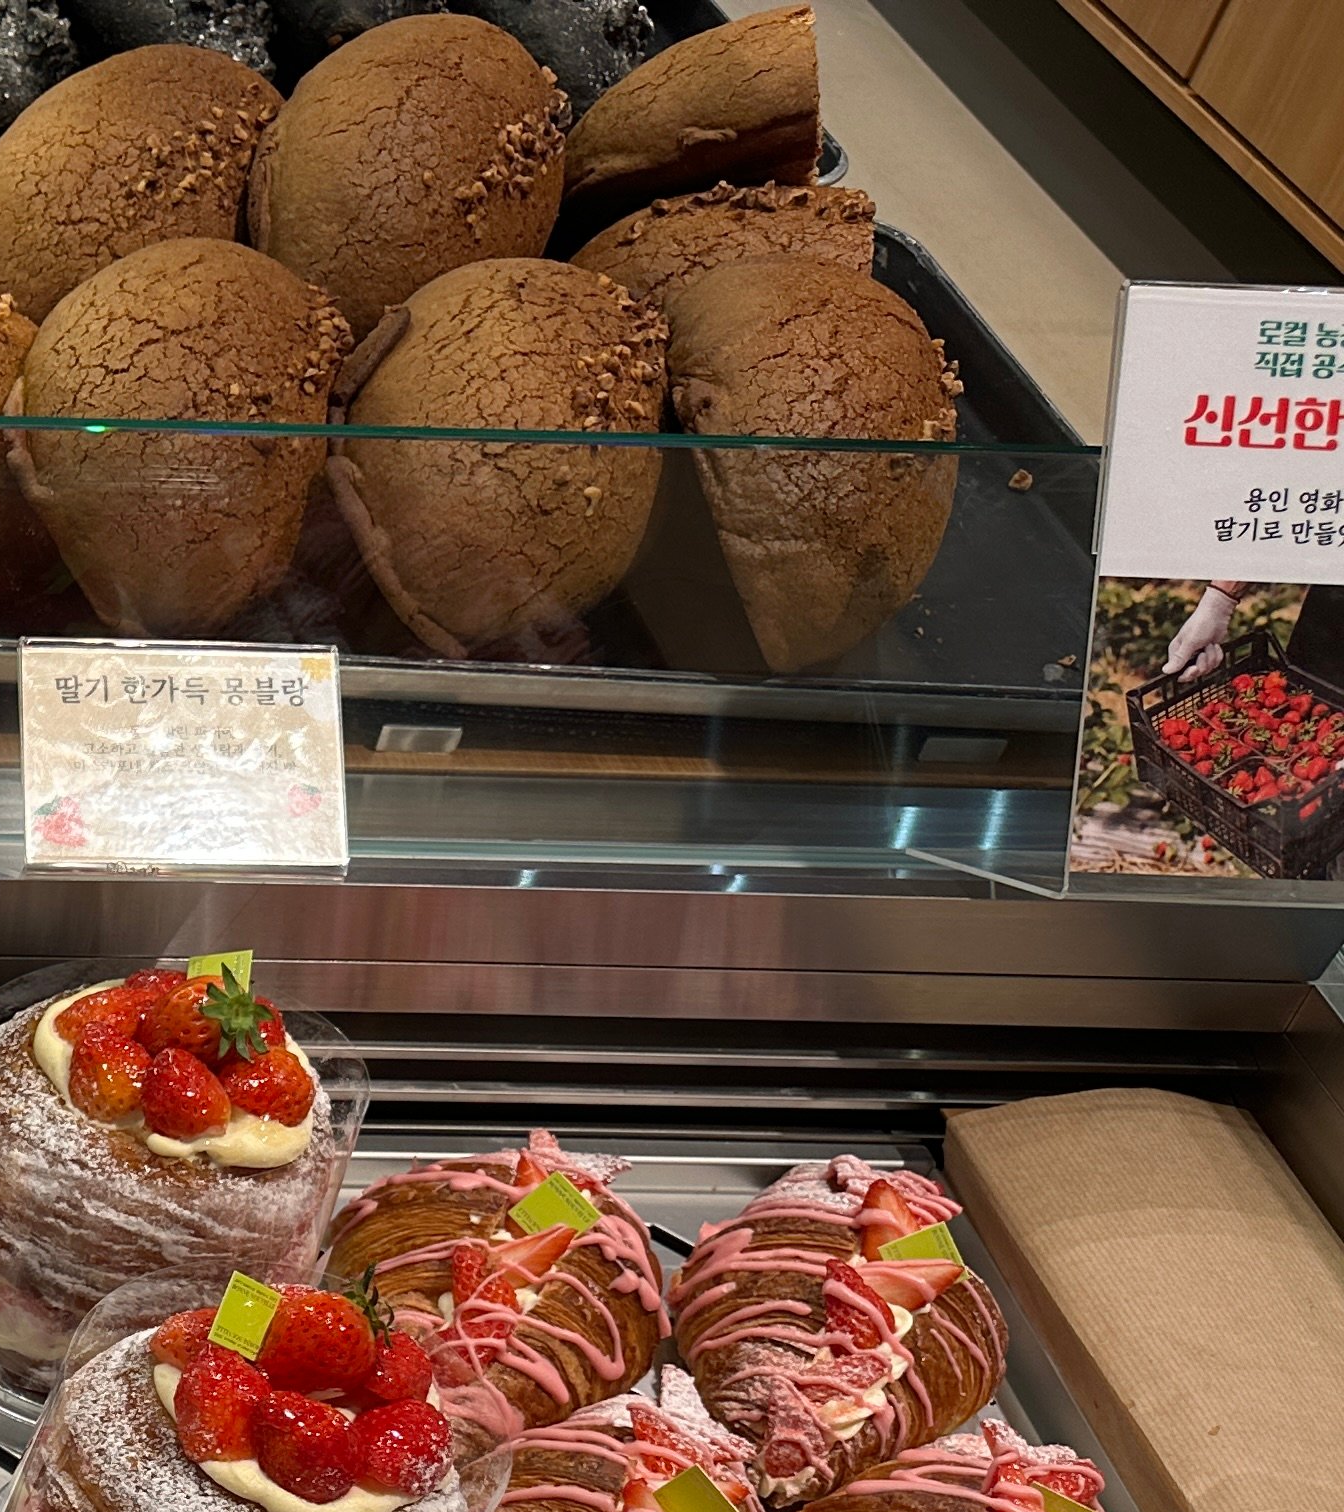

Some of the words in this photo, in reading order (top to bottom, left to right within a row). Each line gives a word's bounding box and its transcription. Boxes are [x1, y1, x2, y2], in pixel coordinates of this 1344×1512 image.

[1257, 320, 1308, 347] 로컬
[1315, 322, 1344, 348] 농
[1254, 351, 1304, 378] 직접
[1184, 394, 1344, 452] 신선한
[1243, 488, 1289, 513] 용인
[1214, 517, 1284, 542] 딸기로
[55, 675, 108, 704] 딸기
[120, 675, 210, 706] 한가득
[219, 677, 310, 708] 몽블랑
